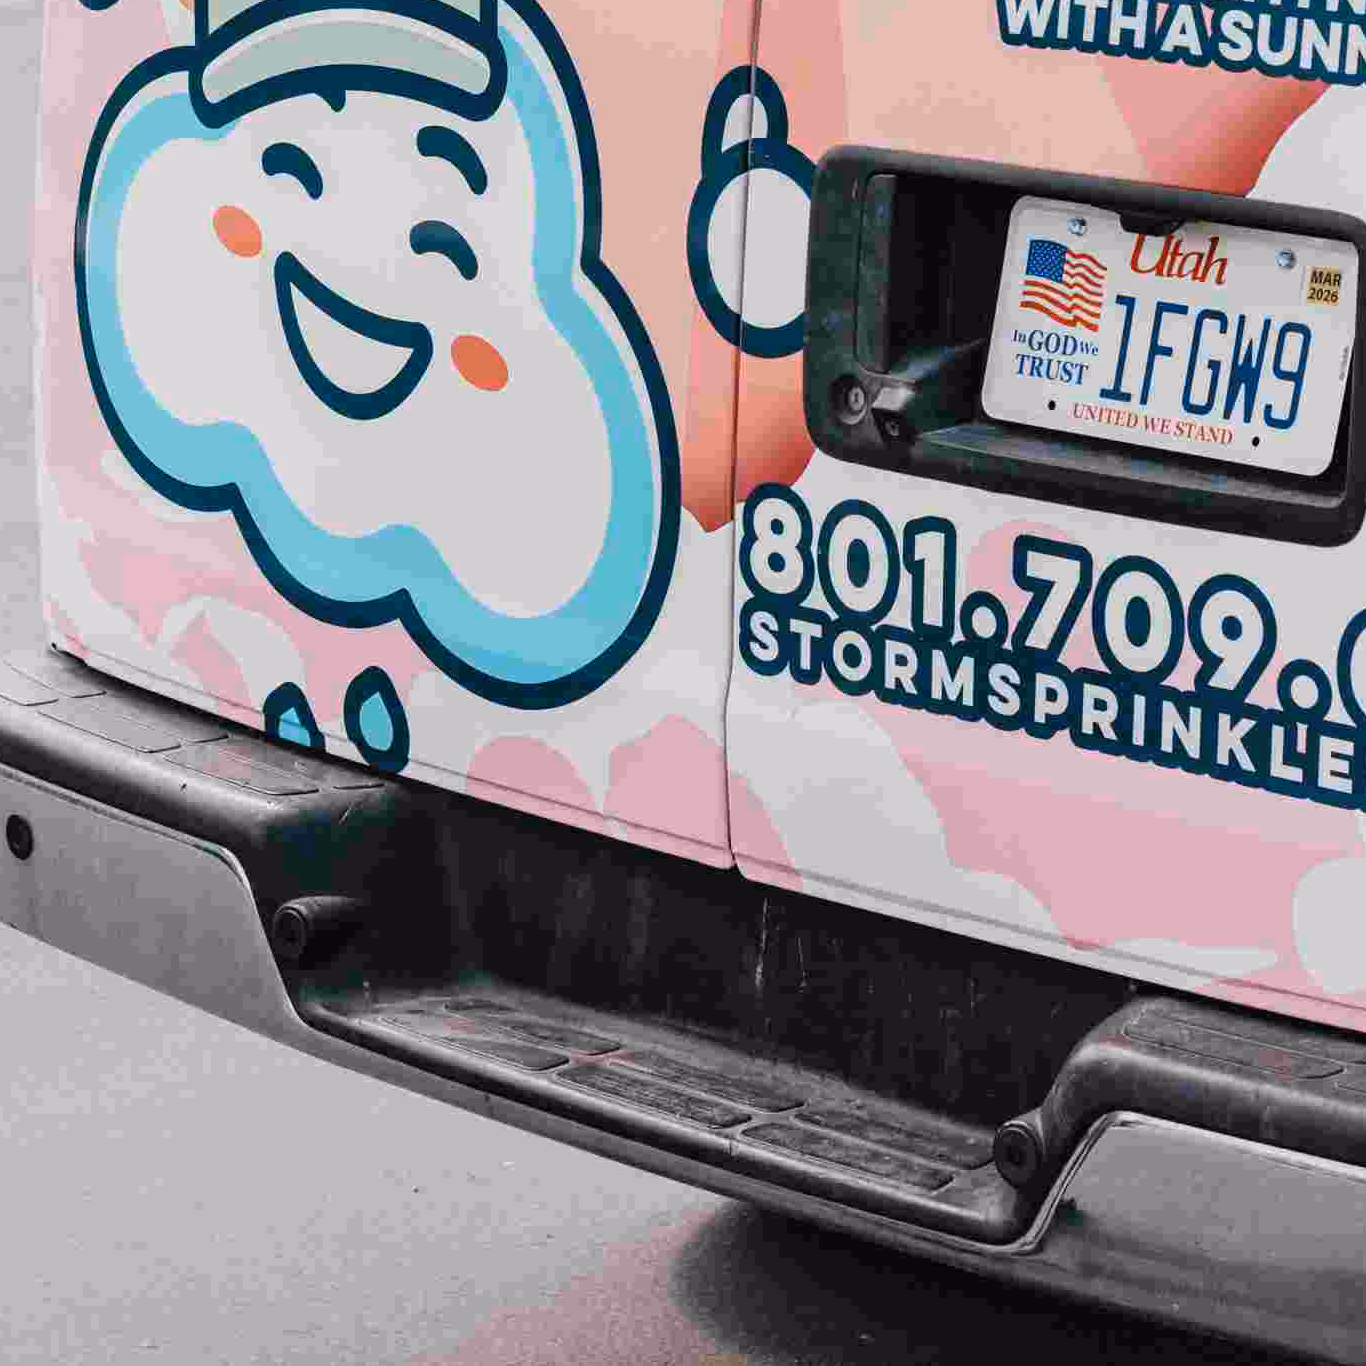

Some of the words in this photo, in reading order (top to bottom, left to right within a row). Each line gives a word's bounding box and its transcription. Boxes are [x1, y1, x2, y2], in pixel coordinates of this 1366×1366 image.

[1159, 4, 1205, 56] A
[1129, 233, 1228, 286] Utah
[1309, 269, 1342, 287] MAR
[1306, 287, 1340, 304] 2026
[1027, 329, 1077, 355] GOD
[1015, 353, 1090, 386] TRUST
[1098, 294, 1313, 430] 1FGW9
[1072, 402, 1138, 428] UNITED
[1143, 414, 1172, 435] WE
[1172, 419, 1235, 445] STAND
